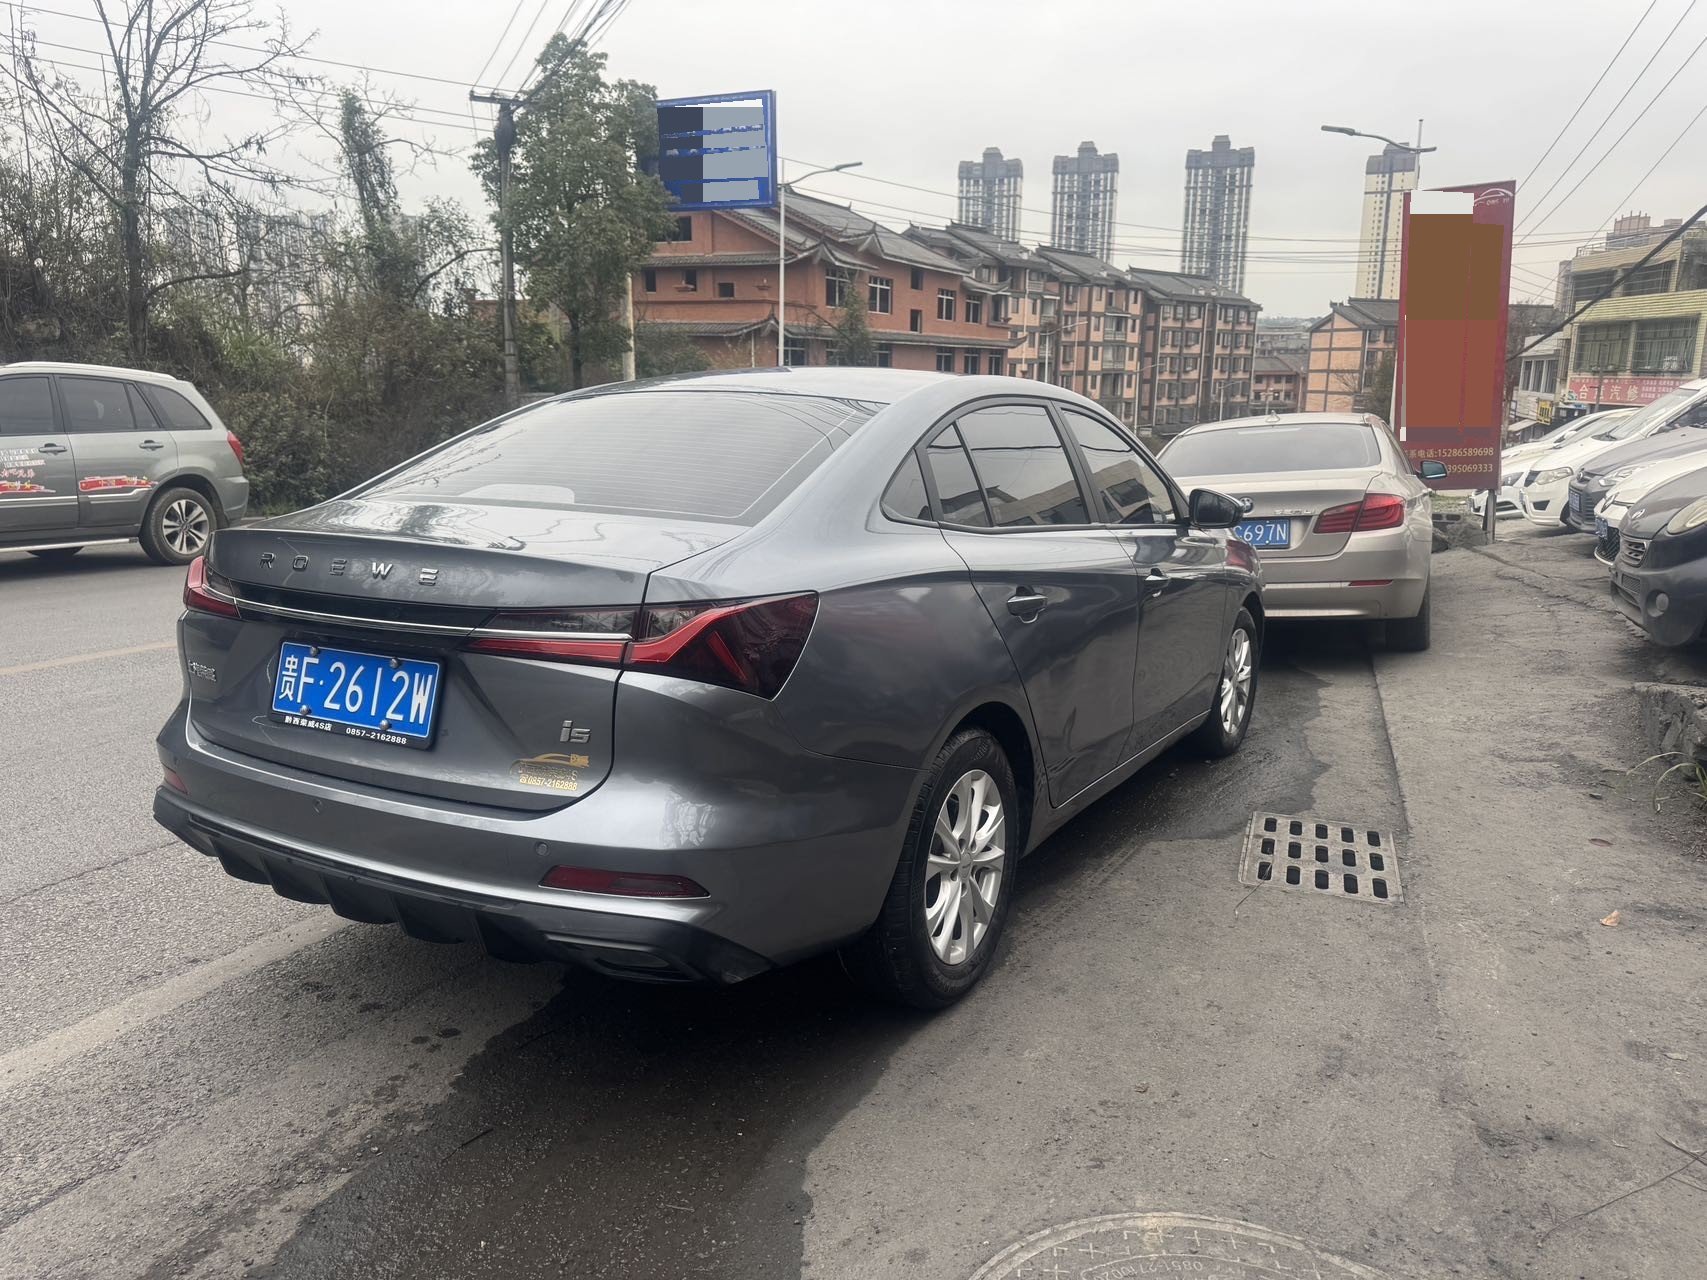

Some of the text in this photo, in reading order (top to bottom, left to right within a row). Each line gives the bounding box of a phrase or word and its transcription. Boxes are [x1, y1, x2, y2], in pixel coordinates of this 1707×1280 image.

[259, 551, 439, 586] ROEWE
[284, 715, 407, 745] 黔西荣威4S店 0857-2162888
